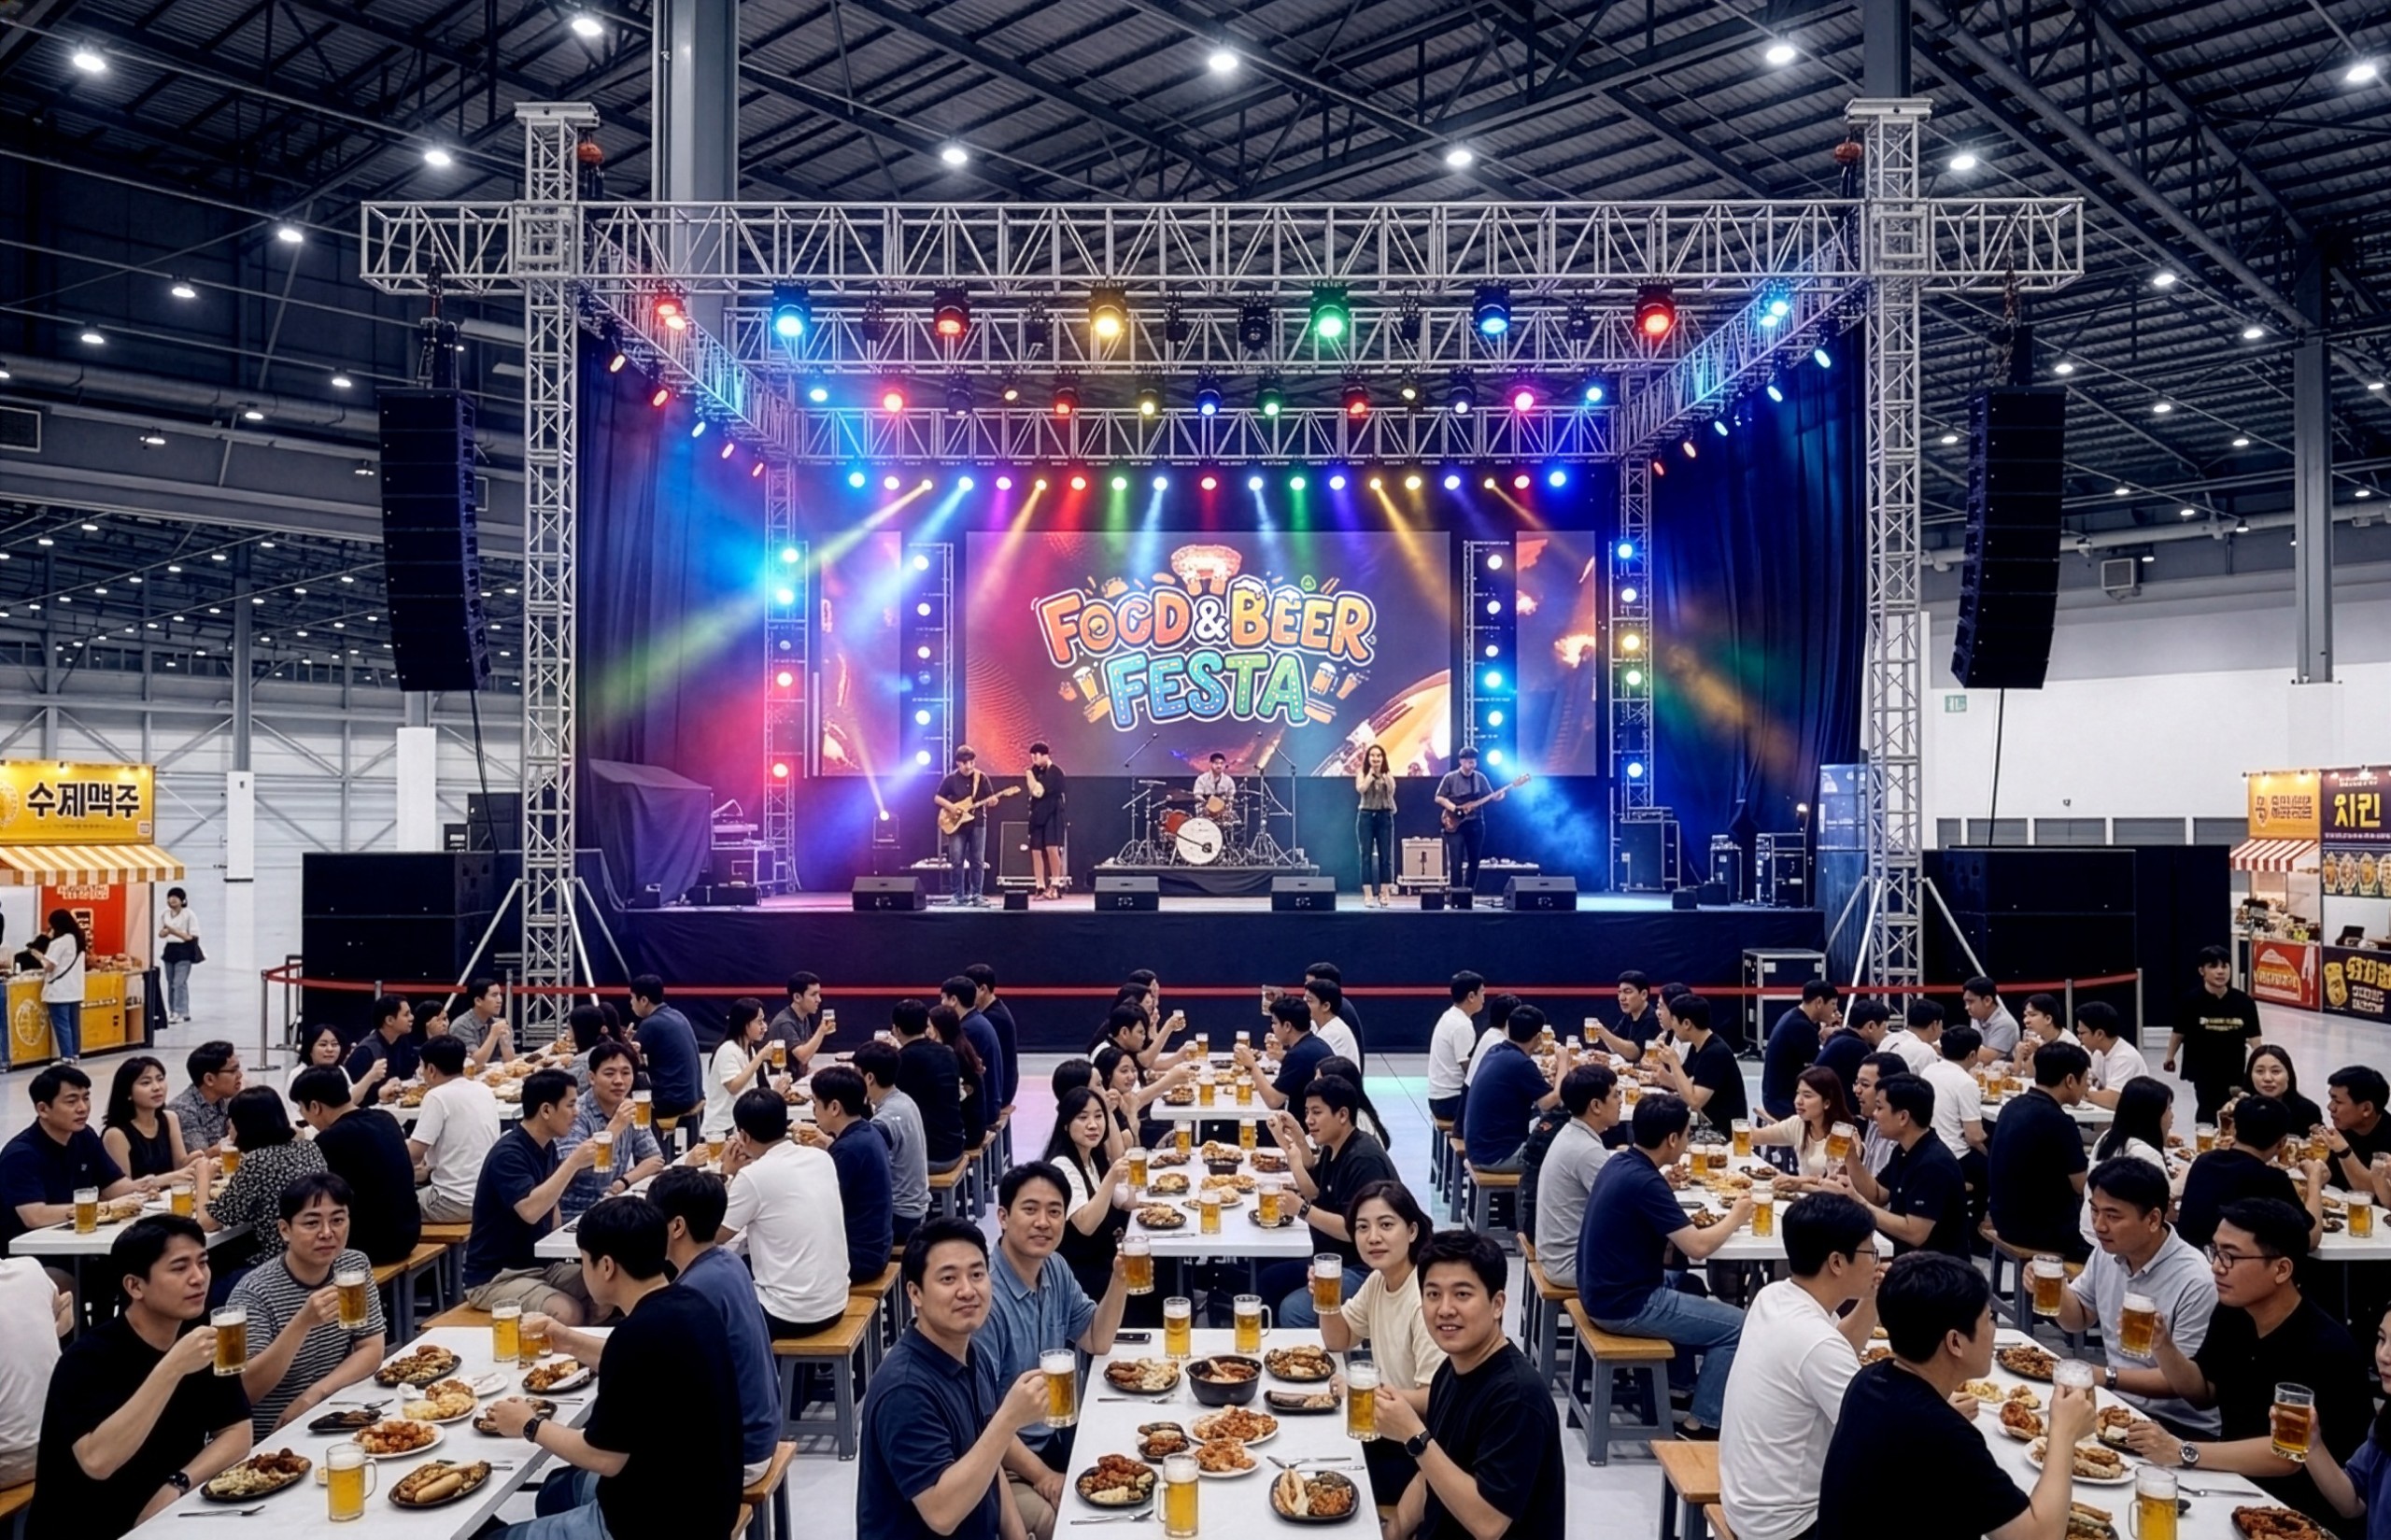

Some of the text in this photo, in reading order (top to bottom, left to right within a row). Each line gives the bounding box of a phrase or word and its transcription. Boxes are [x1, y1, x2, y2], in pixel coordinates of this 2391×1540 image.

[1229, 578, 1372, 660] BEER
[1105, 651, 1307, 727] FESTA
[27, 782, 139, 818] 수제맥주
